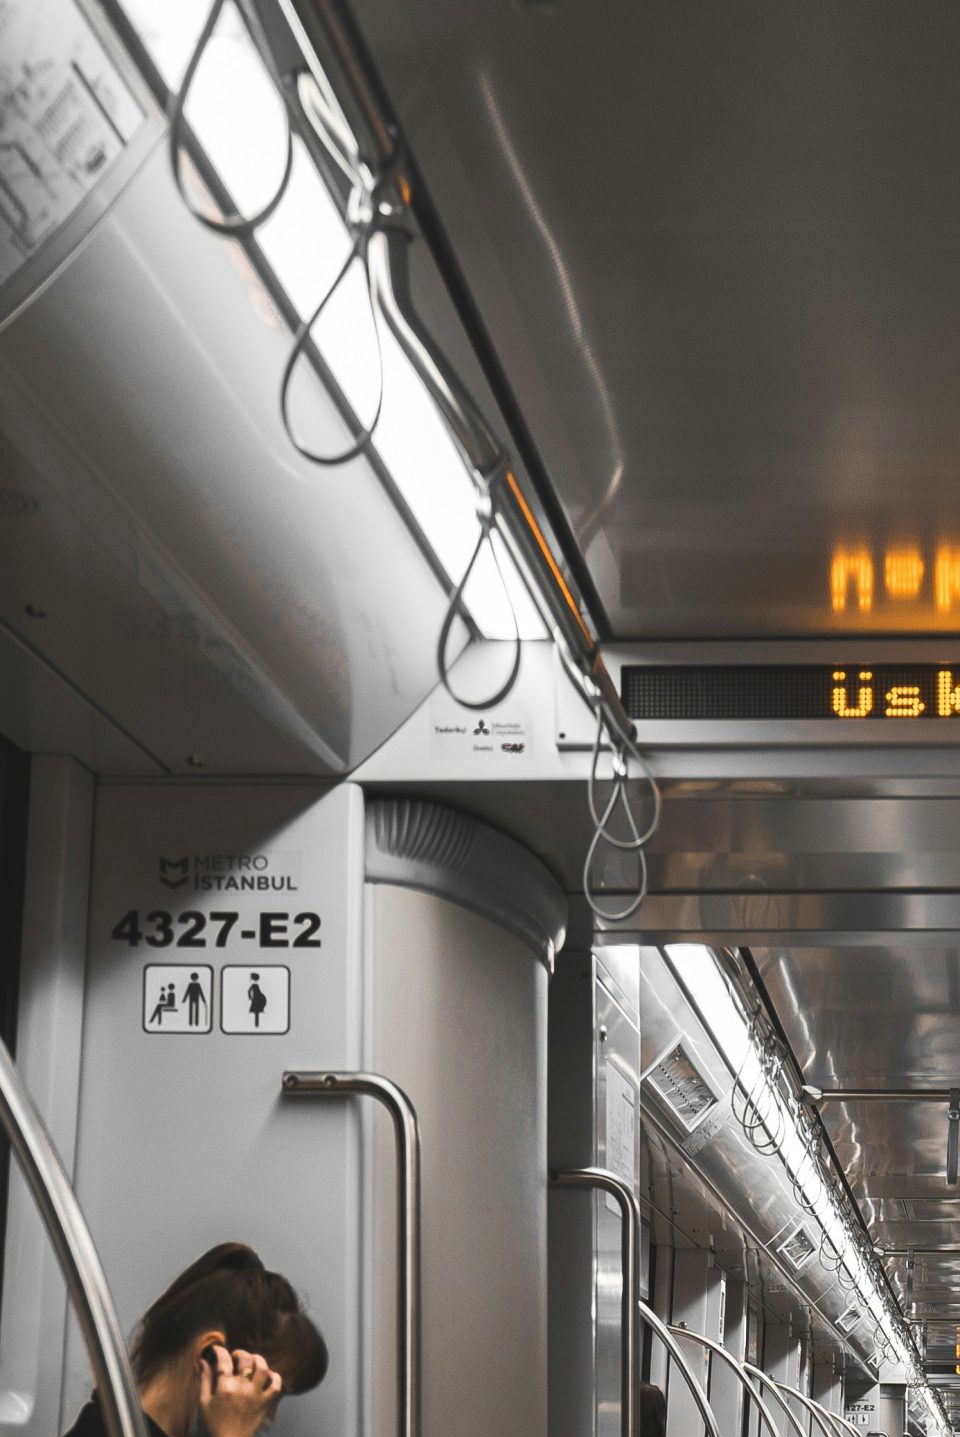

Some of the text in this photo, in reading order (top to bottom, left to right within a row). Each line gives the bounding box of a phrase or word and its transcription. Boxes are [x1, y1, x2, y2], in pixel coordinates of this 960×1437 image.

[193, 854, 268, 871] METRO
[193, 873, 298, 891] İSTANBUL
[111, 910, 322, 948] 4327-E2
